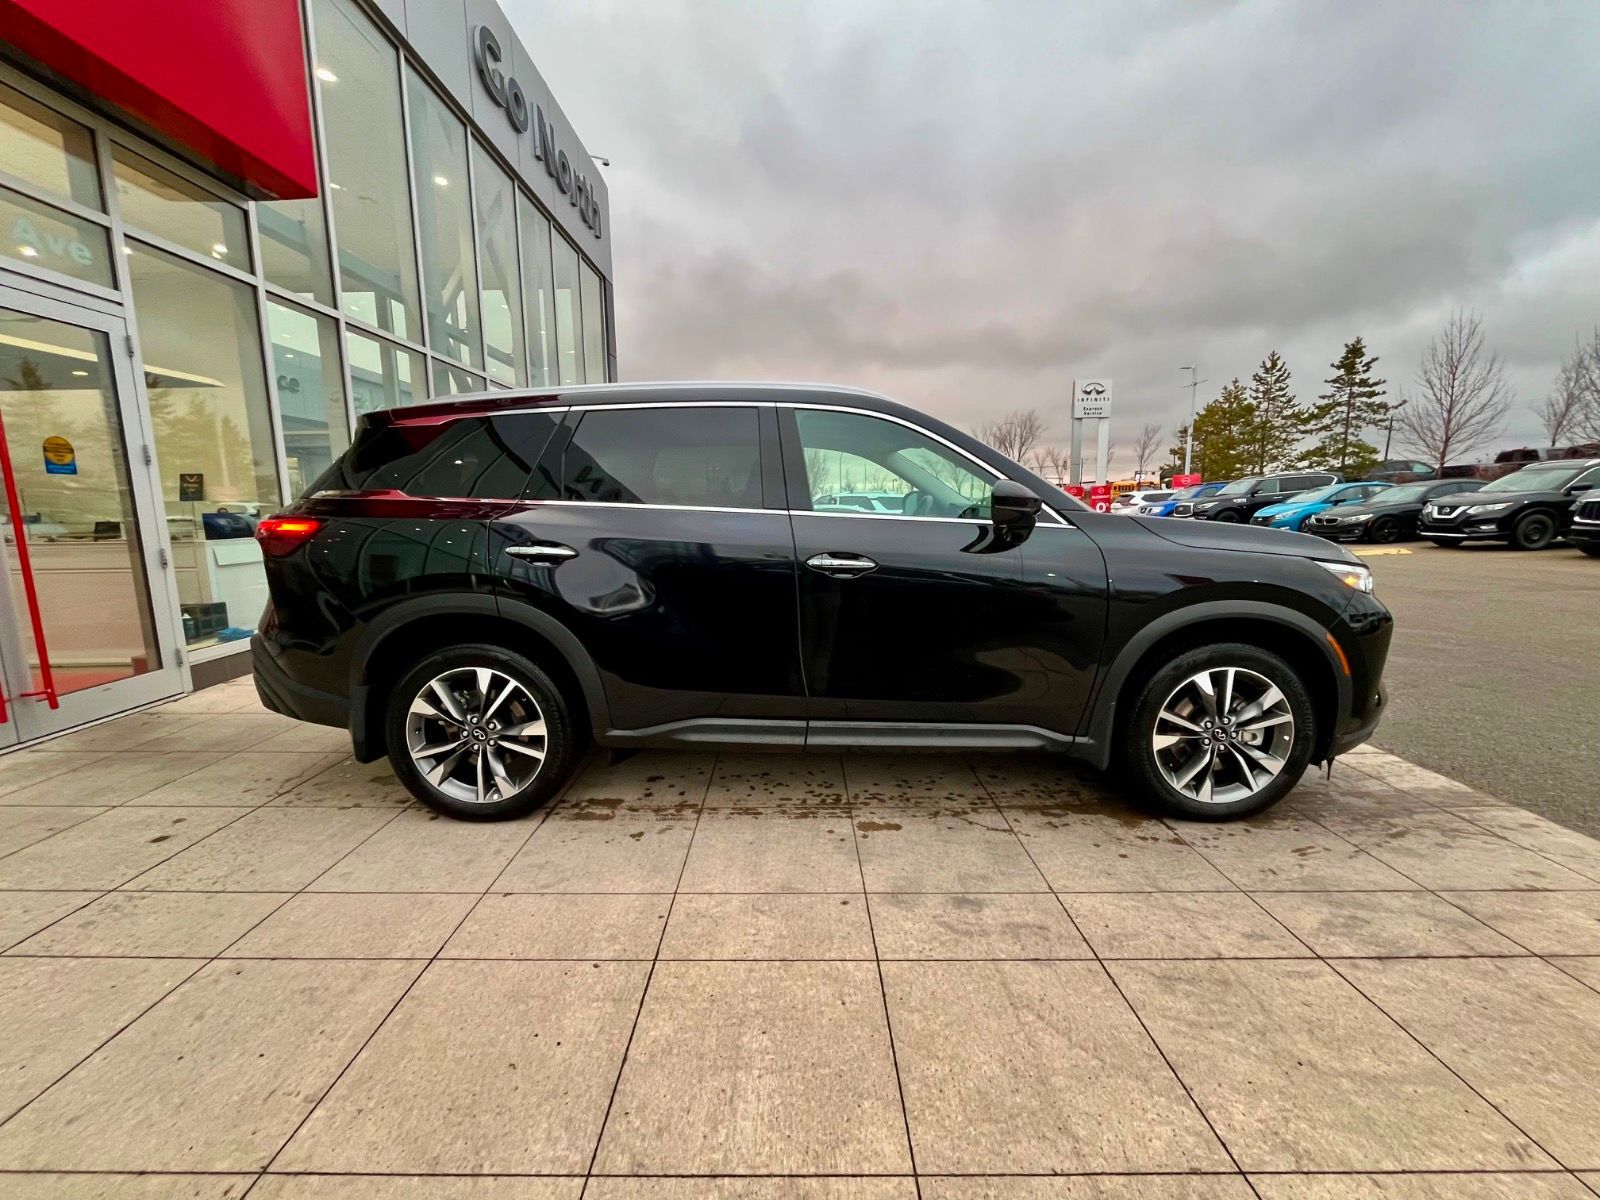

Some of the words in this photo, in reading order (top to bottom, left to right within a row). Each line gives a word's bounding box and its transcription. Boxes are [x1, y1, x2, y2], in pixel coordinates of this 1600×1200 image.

[473, 25, 529, 135] Go
[531, 101, 601, 239] North
[11, 216, 94, 266] Ave
